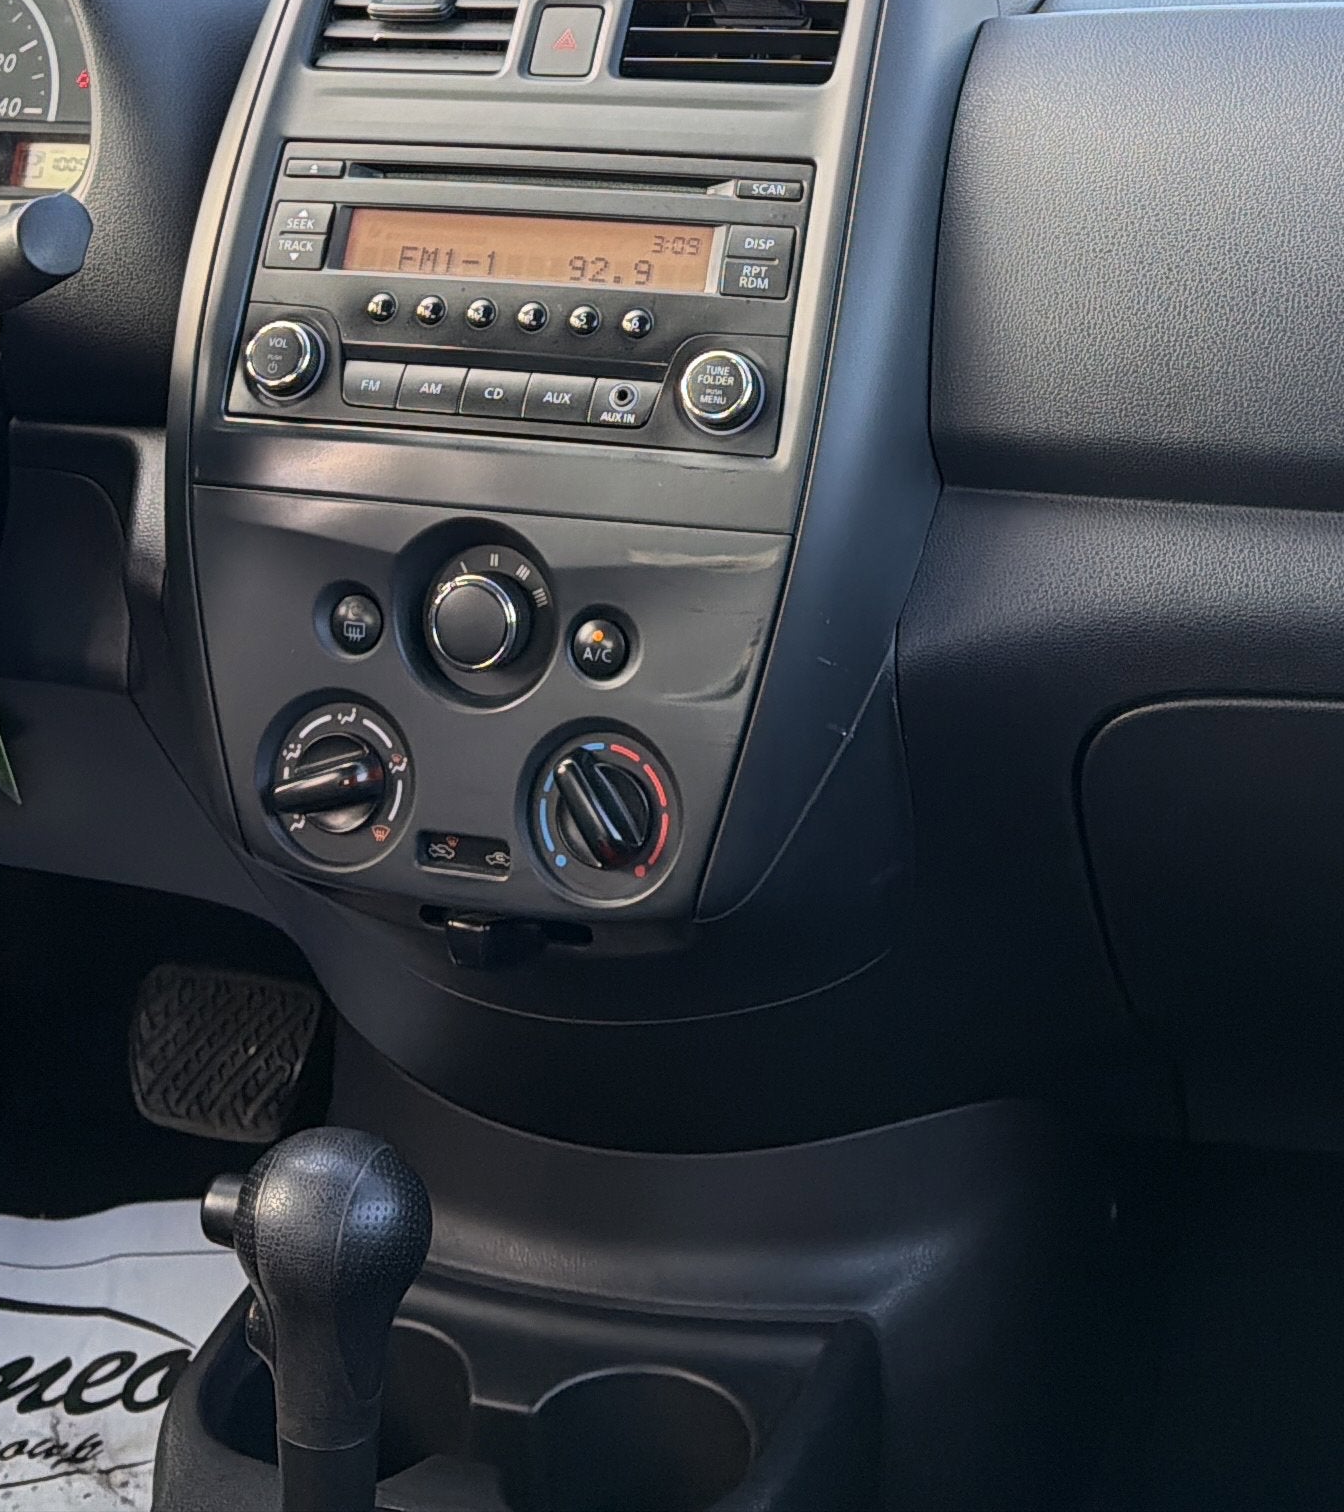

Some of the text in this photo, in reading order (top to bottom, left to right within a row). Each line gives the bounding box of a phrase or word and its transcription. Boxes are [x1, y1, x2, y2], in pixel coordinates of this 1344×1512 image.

[751, 183, 786, 196] SCAN
[286, 217, 315, 230] SEEK
[278, 239, 314, 252] TRACK
[652, 235, 701, 256] 3:09
[744, 237, 775, 250] DISP
[398, 245, 654, 285] FM1-1 92.9
[742, 264, 768, 278] RPT
[738, 276, 769, 290] RDM
[268, 337, 289, 349] VOL
[706, 364, 731, 376] TUNE
[360, 378, 381, 391] FM
[697, 374, 735, 387] FOLDER
[419, 382, 442, 395] AM
[484, 387, 504, 400] CD
[542, 391, 572, 405] AUX
[699, 394, 727, 405] MENU
[600, 411, 635, 424] AUX IN
[582, 646, 612, 664] A/C
